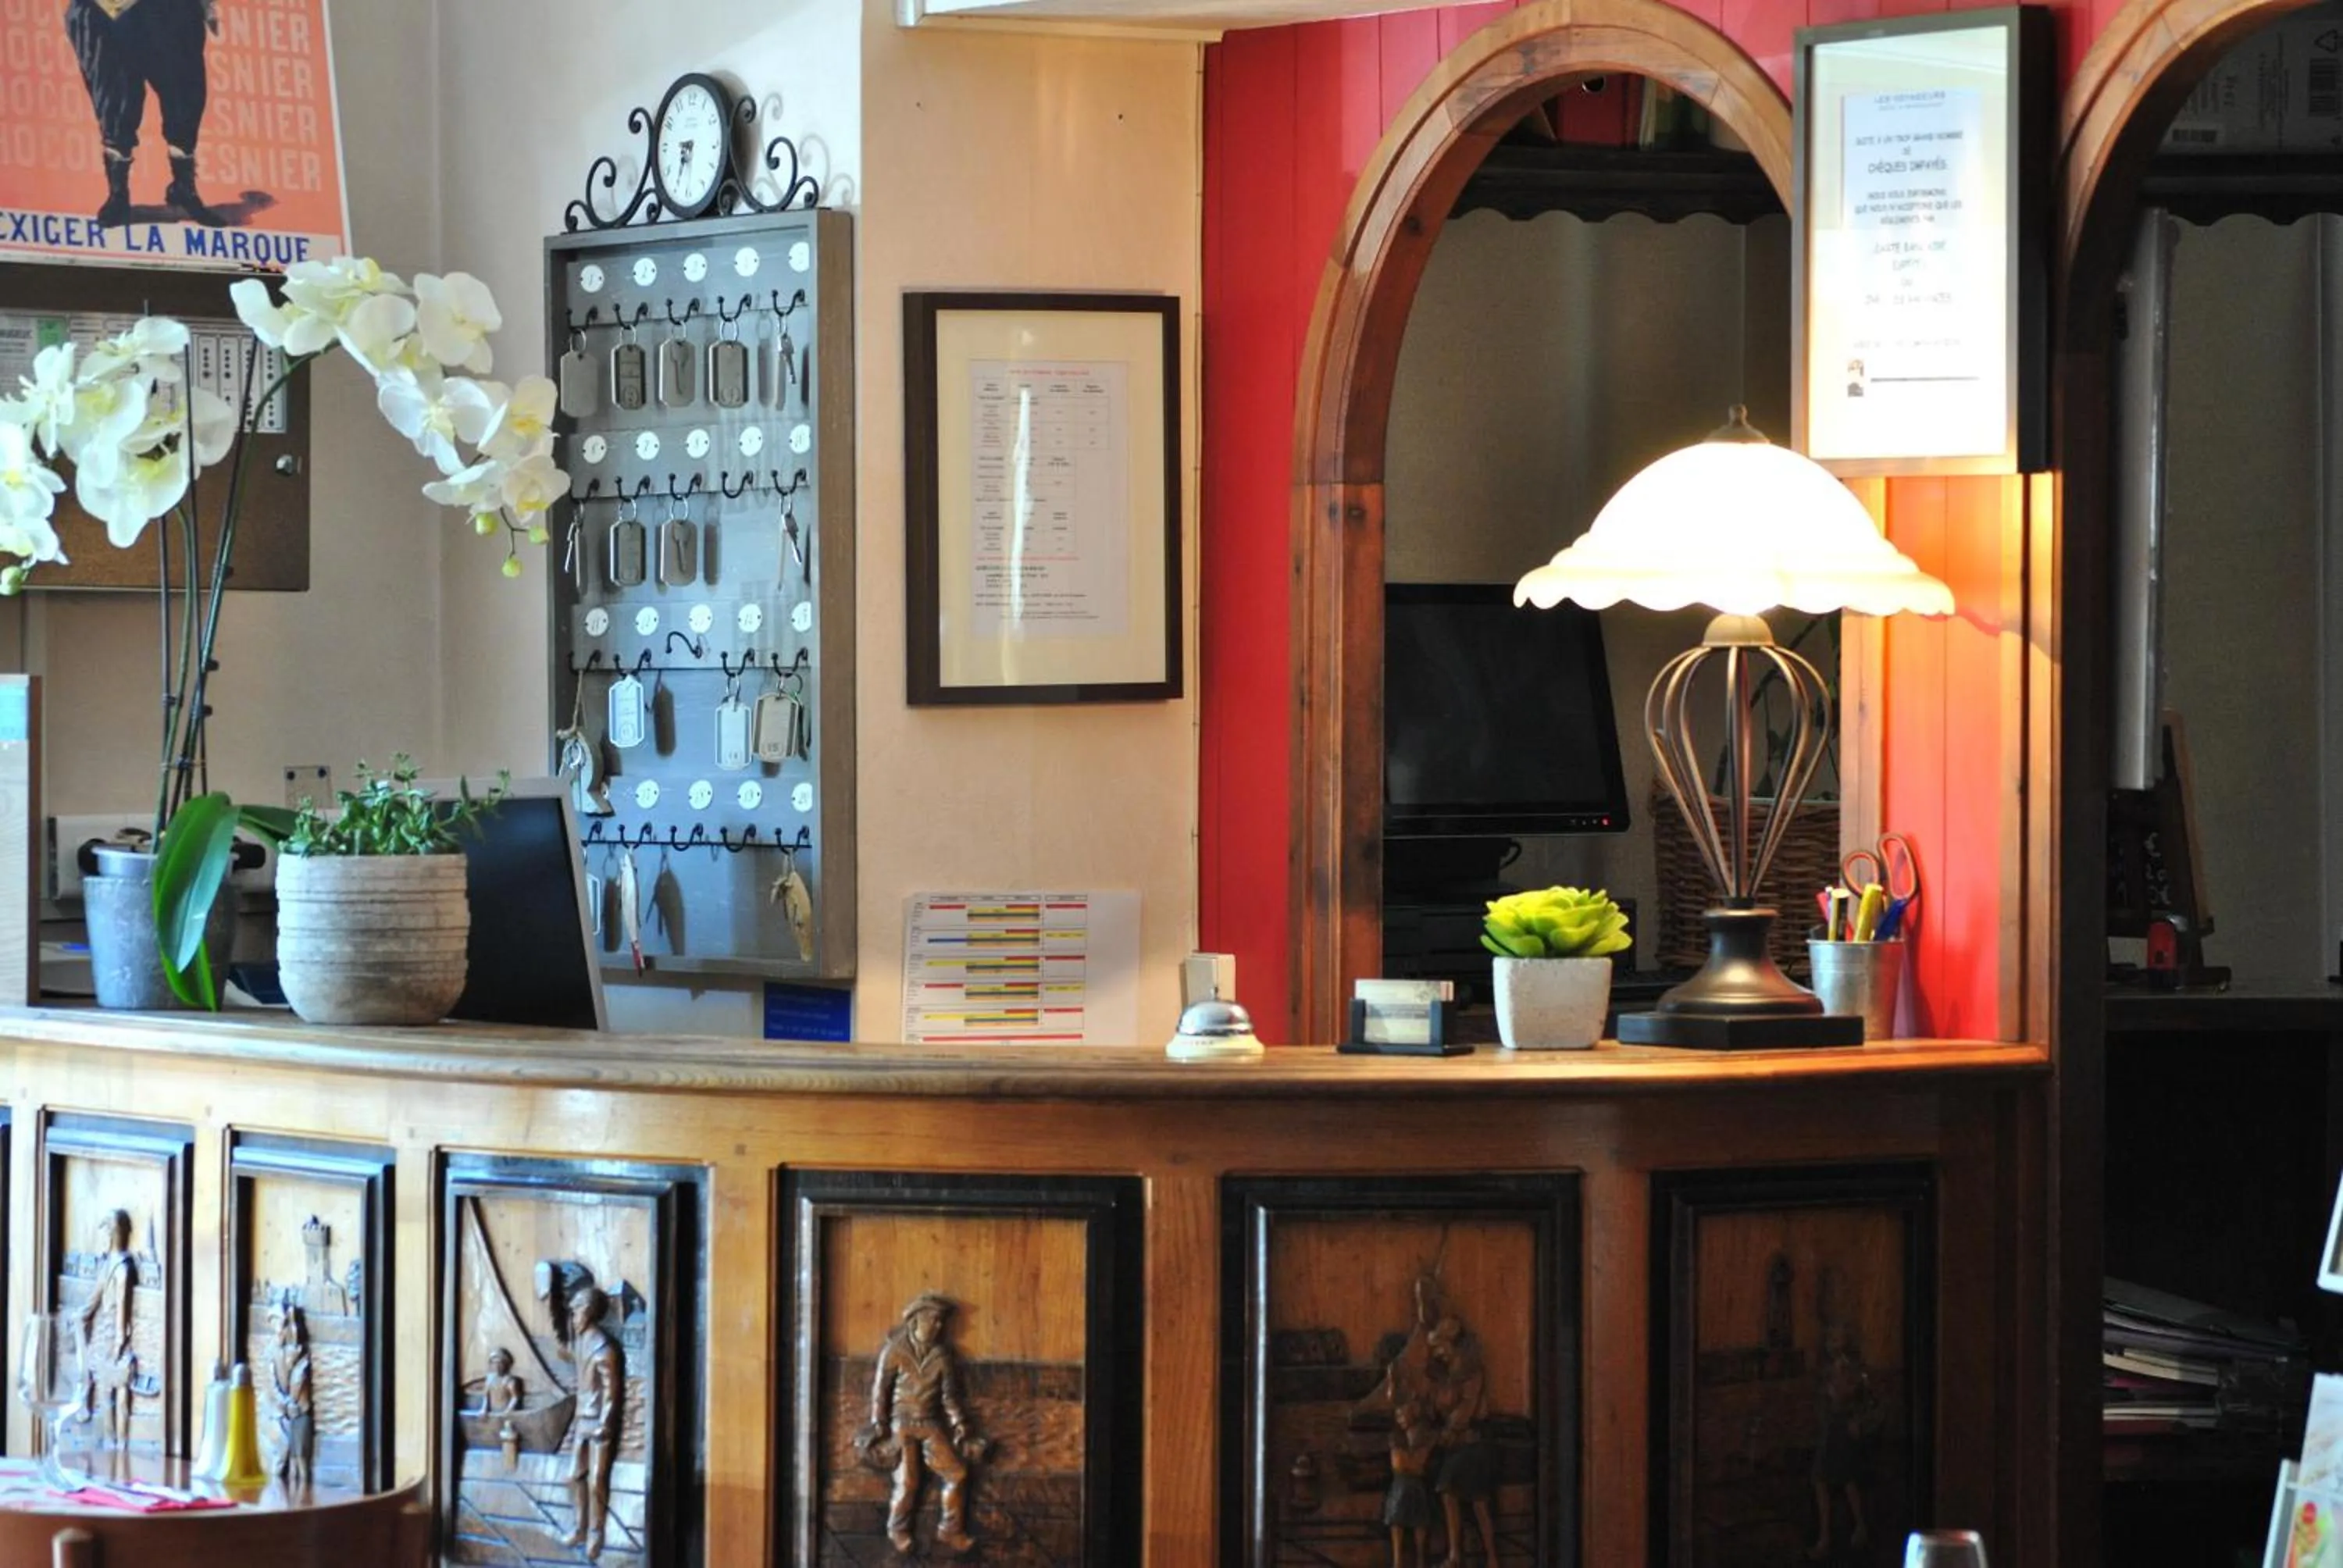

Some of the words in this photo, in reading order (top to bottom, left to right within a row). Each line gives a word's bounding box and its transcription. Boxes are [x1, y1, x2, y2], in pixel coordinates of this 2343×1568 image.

[209, 50, 313, 99] SNIER
[200, 98, 319, 146] SNIER
[125, 224, 166, 253] LA
[184, 227, 310, 265] MARQUE
